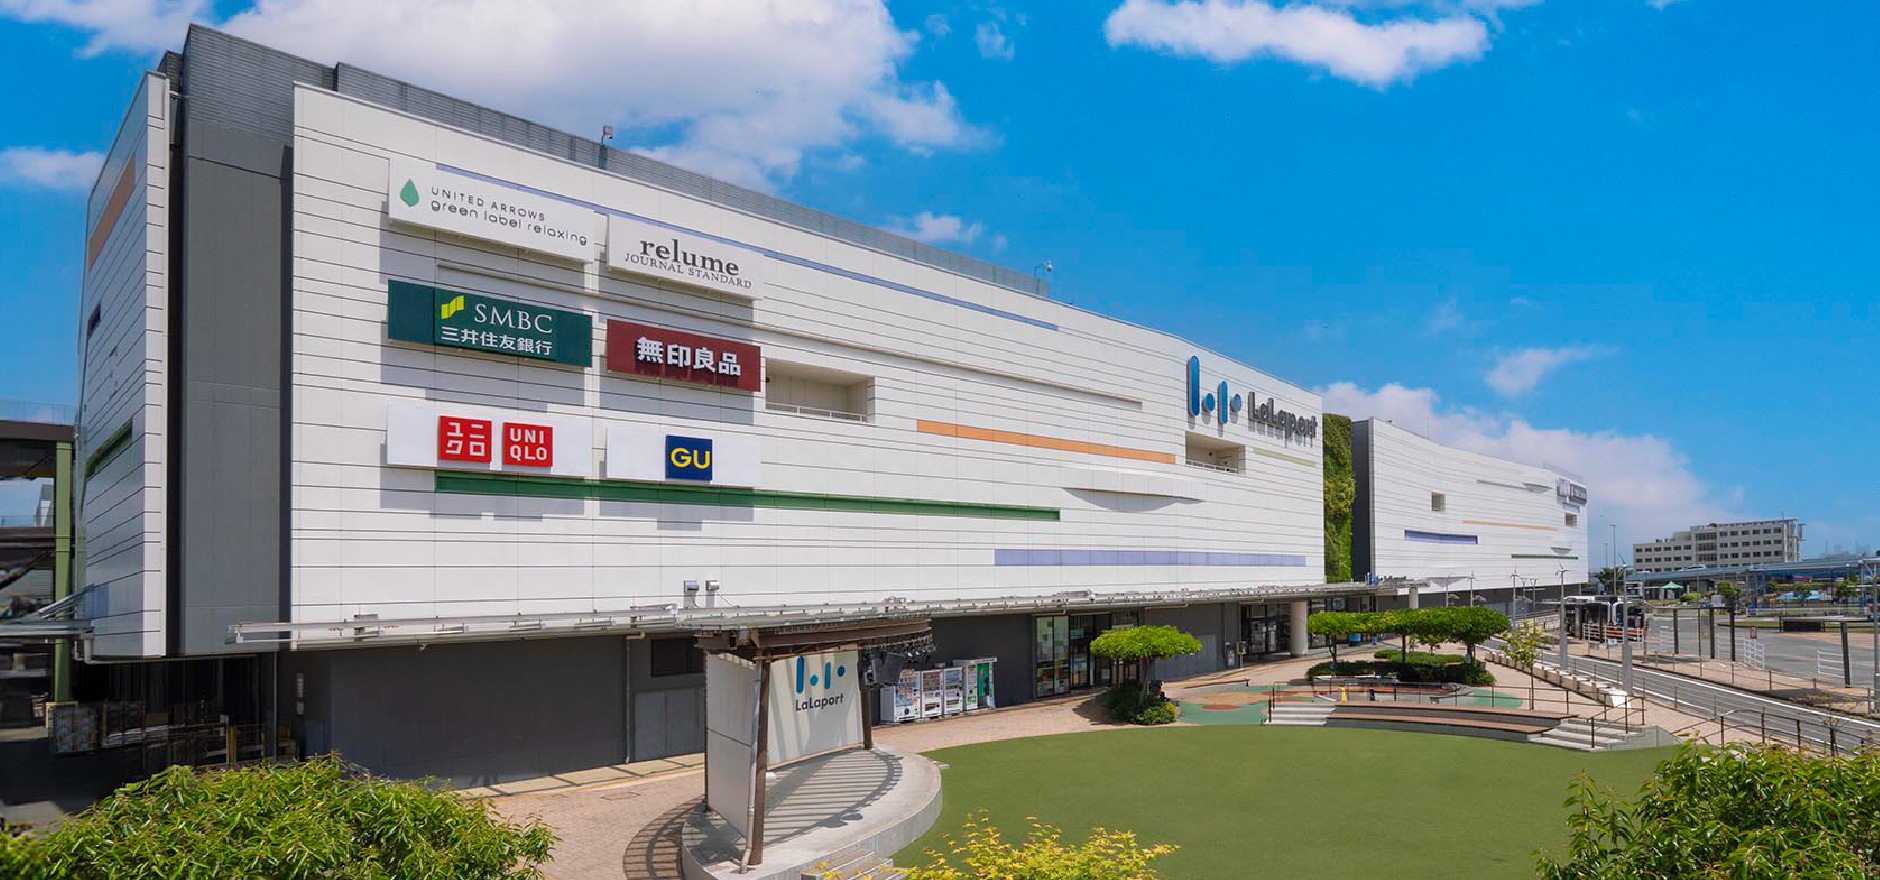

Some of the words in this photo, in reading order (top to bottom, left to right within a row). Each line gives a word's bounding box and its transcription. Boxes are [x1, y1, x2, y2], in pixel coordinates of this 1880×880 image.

[431, 186, 484, 207] UNITED
[491, 201, 545, 222] ARROWS
[431, 200, 478, 218] green
[484, 211, 521, 229] label
[528, 223, 587, 246] relaxing
[625, 253, 684, 275] JOURNAL
[688, 267, 752, 289] STANDARD
[640, 238, 739, 276] relume
[474, 303, 553, 333] SMBC
[441, 326, 553, 356] 三井住友銀行
[636, 336, 742, 377] 無印良品
[1248, 391, 1318, 439] LaLaport
[509, 427, 545, 444] UNI
[509, 444, 548, 462] QLO
[670, 446, 711, 469] GU
[795, 692, 845, 711] LaLaport
